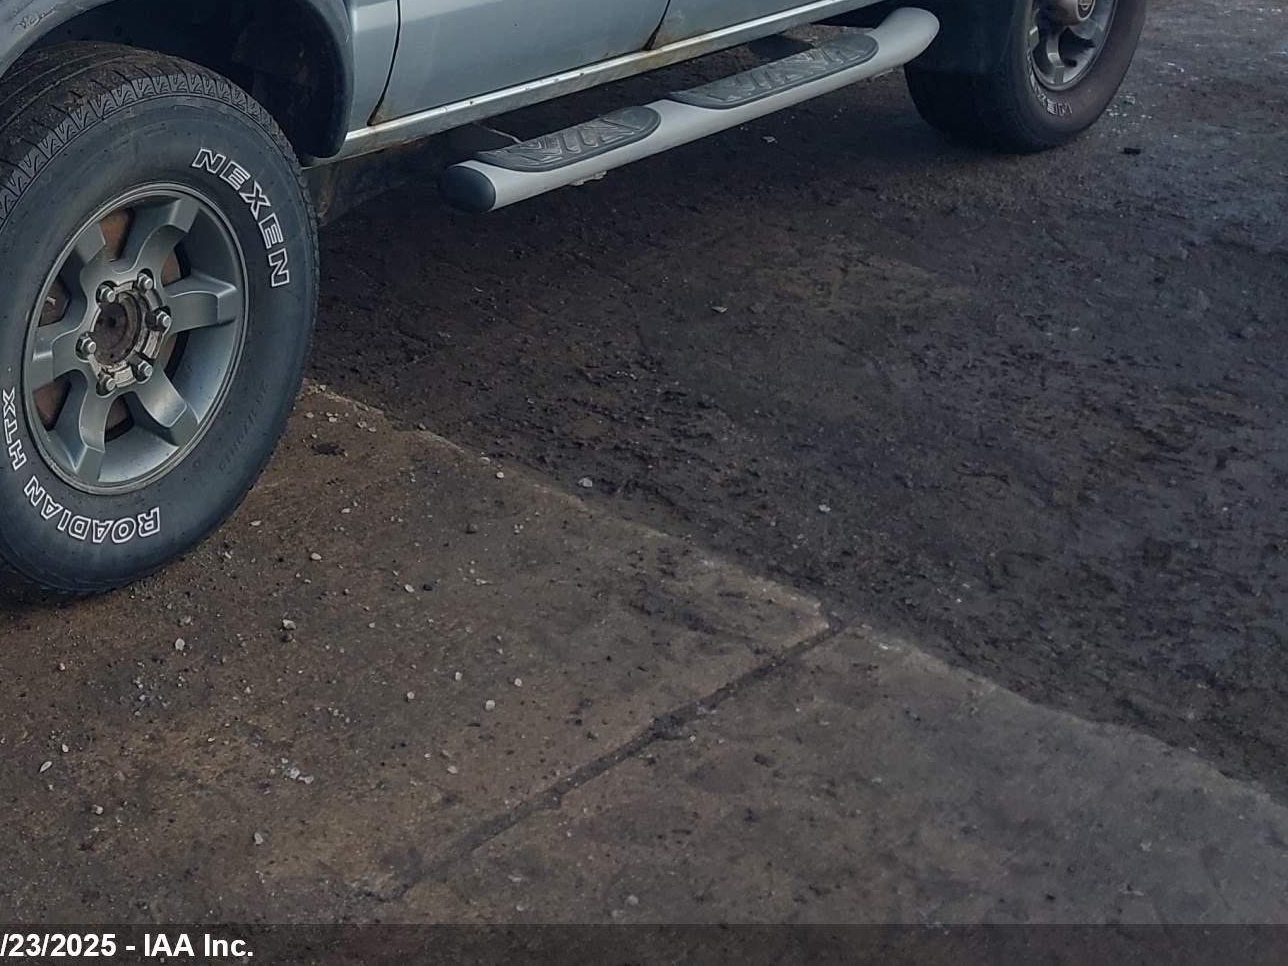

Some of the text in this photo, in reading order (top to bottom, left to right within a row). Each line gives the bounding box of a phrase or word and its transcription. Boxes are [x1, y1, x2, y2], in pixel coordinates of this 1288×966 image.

[191, 147, 290, 288] NEXEN
[2, 386, 161, 544] ROADIAN HTX
